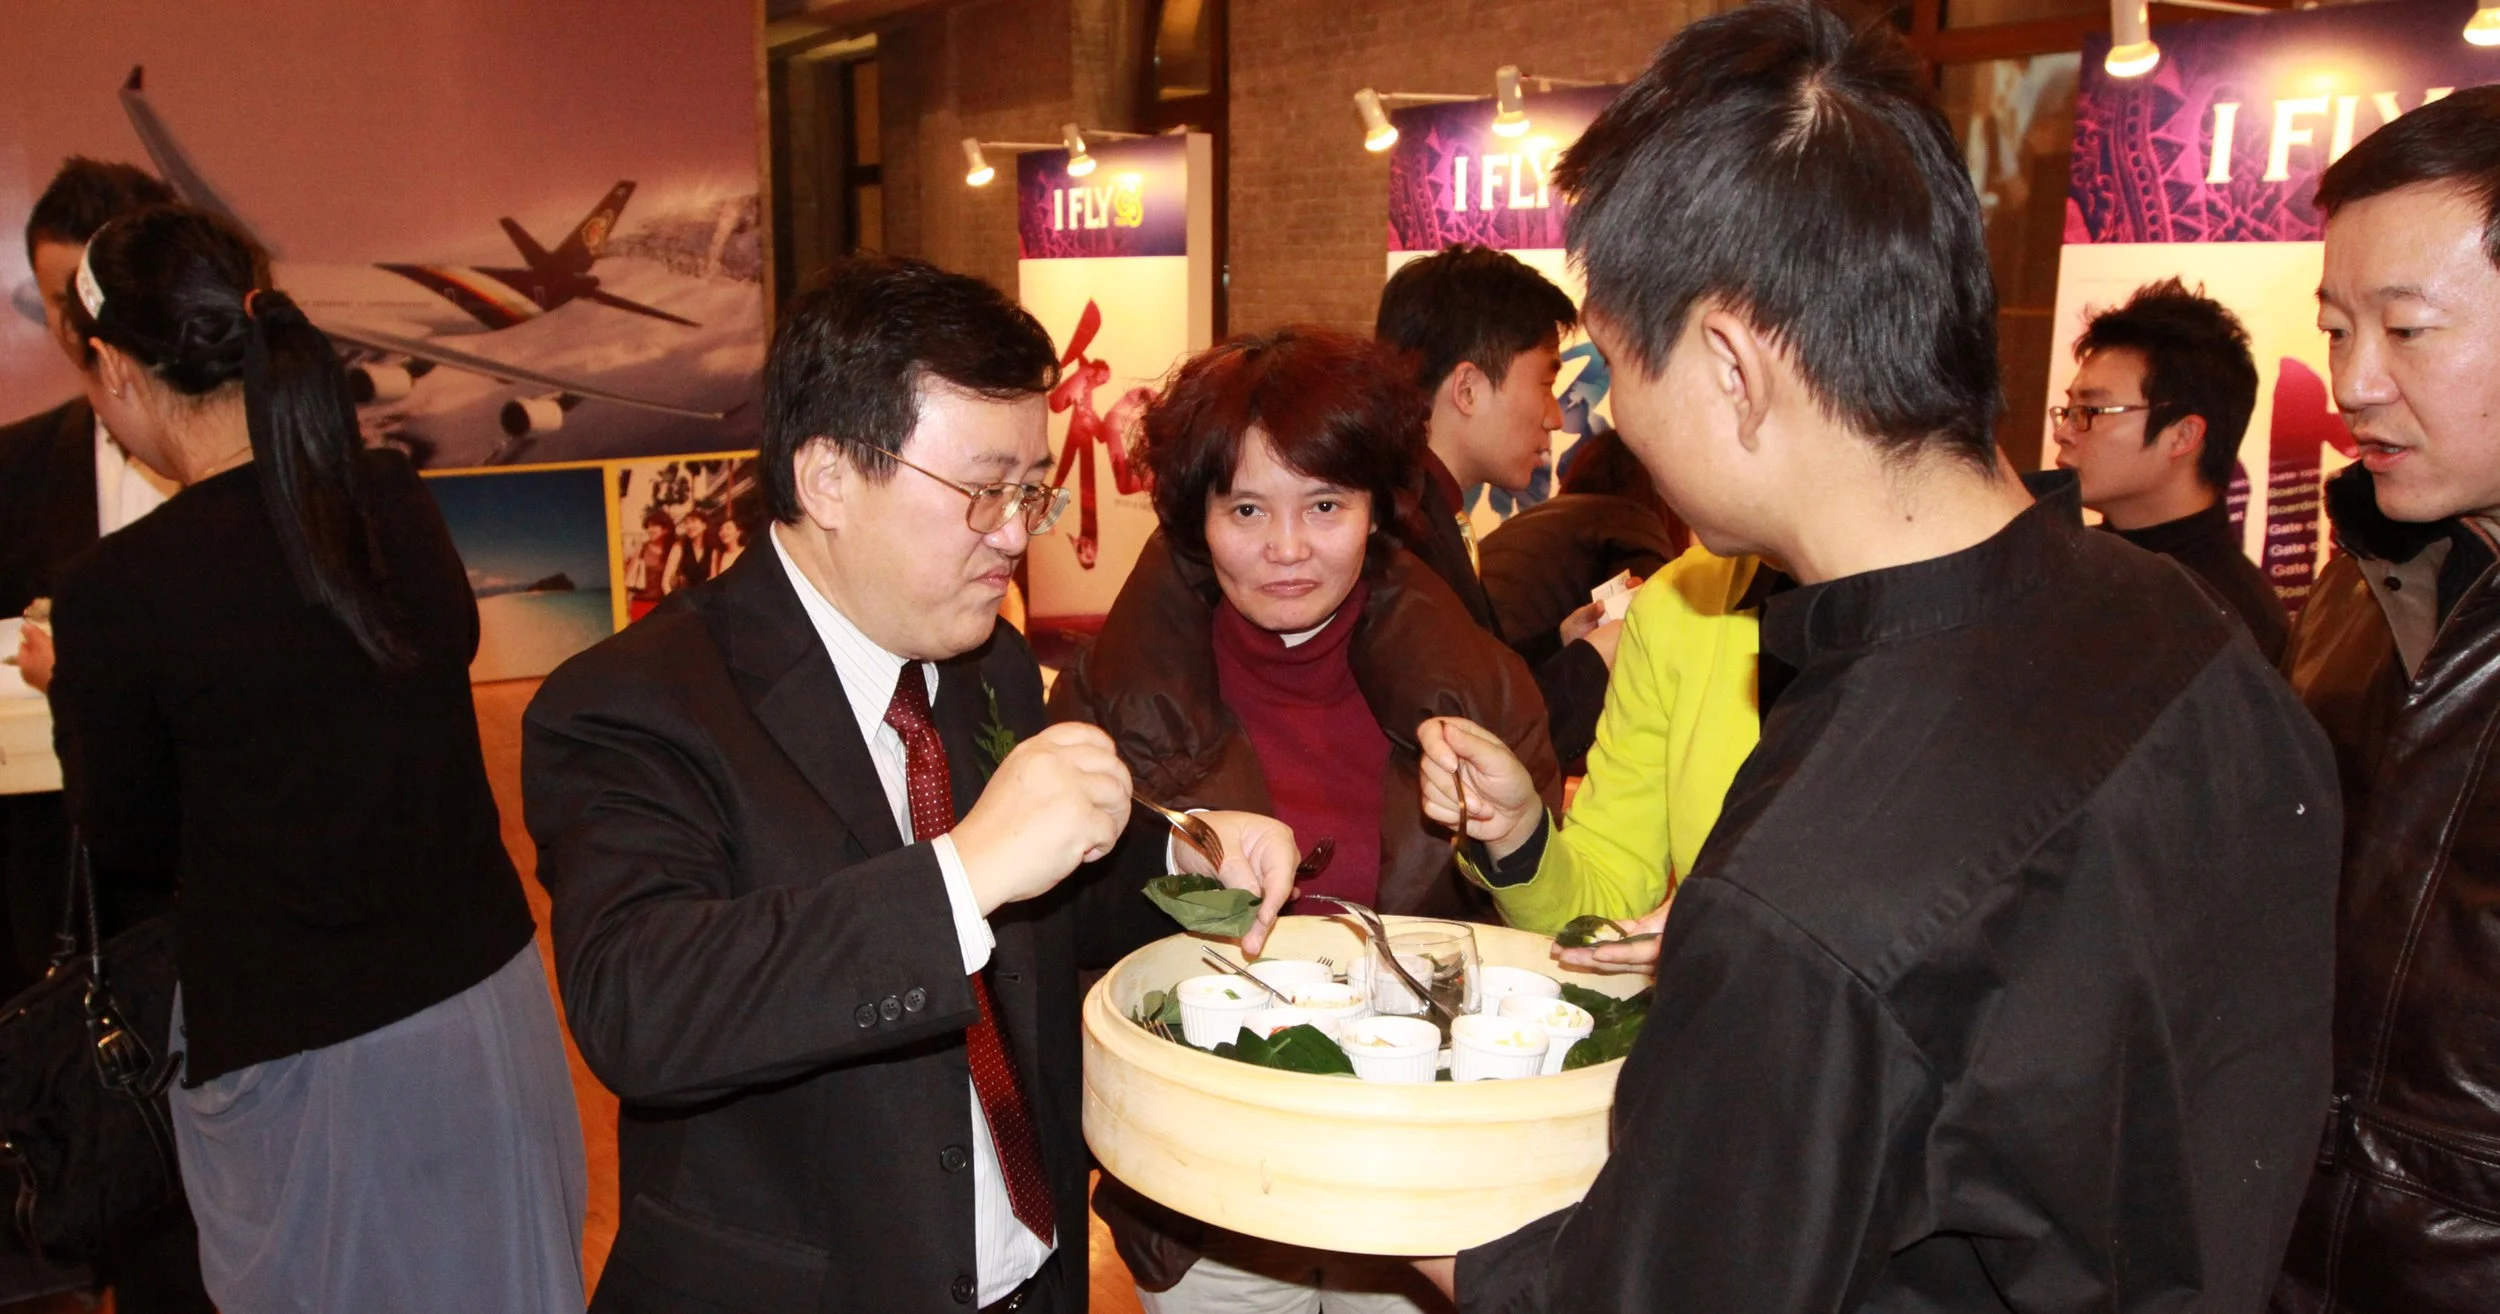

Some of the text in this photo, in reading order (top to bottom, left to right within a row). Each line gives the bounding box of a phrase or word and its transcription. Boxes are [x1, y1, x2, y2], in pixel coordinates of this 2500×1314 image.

[2205, 102, 2241, 184] I
[1053, 186, 1115, 232] I FLY
[1453, 151, 1557, 212] I FLY
